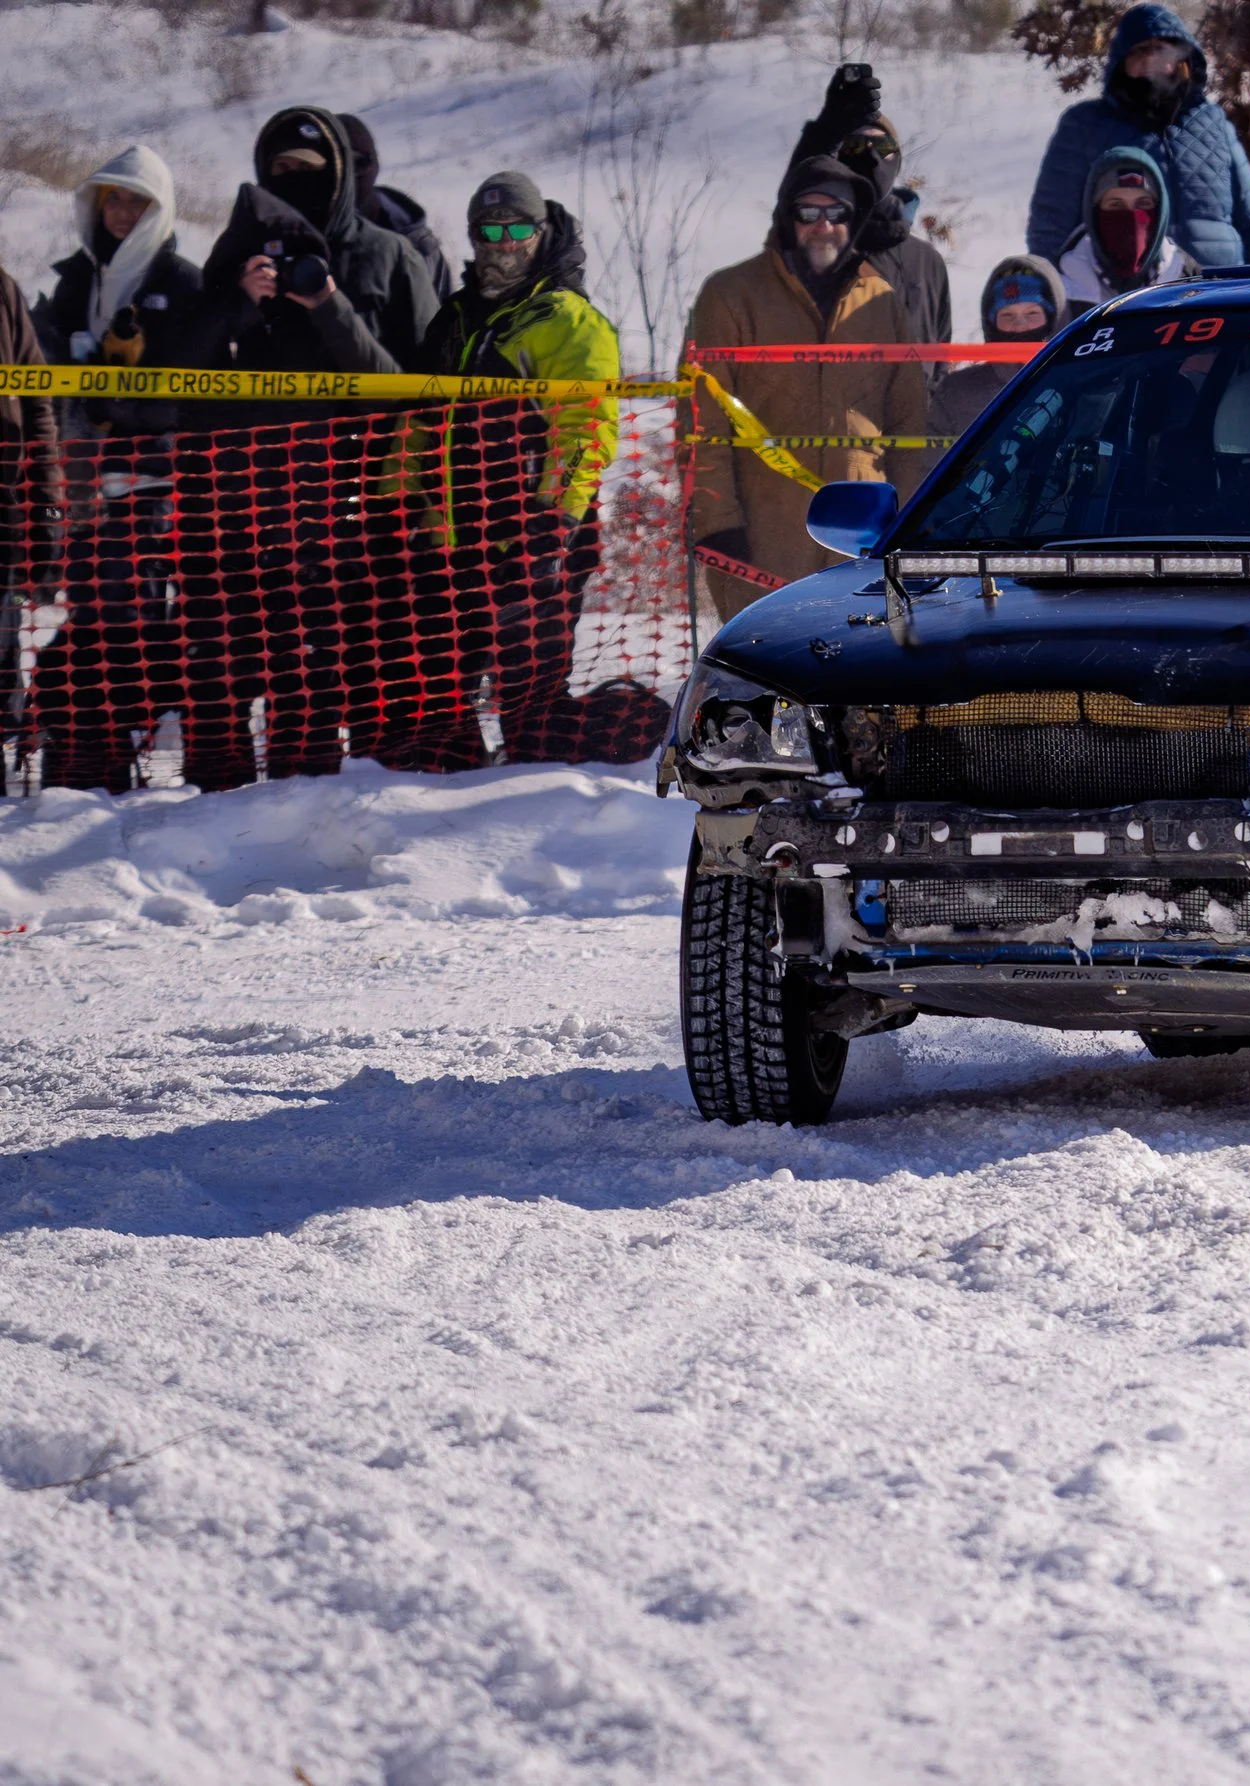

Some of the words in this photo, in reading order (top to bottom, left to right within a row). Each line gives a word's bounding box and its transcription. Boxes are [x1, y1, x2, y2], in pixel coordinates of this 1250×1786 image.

[1093, 327, 1114, 341] R
[1154, 318, 1224, 345] 19
[1074, 339, 1114, 356] 04
[80, 371, 108, 392] DO
[117, 372, 162, 393] NOT
[169, 373, 240, 395] CROSS
[248, 373, 297, 395] THIS
[304, 374, 361, 397] TAPE
